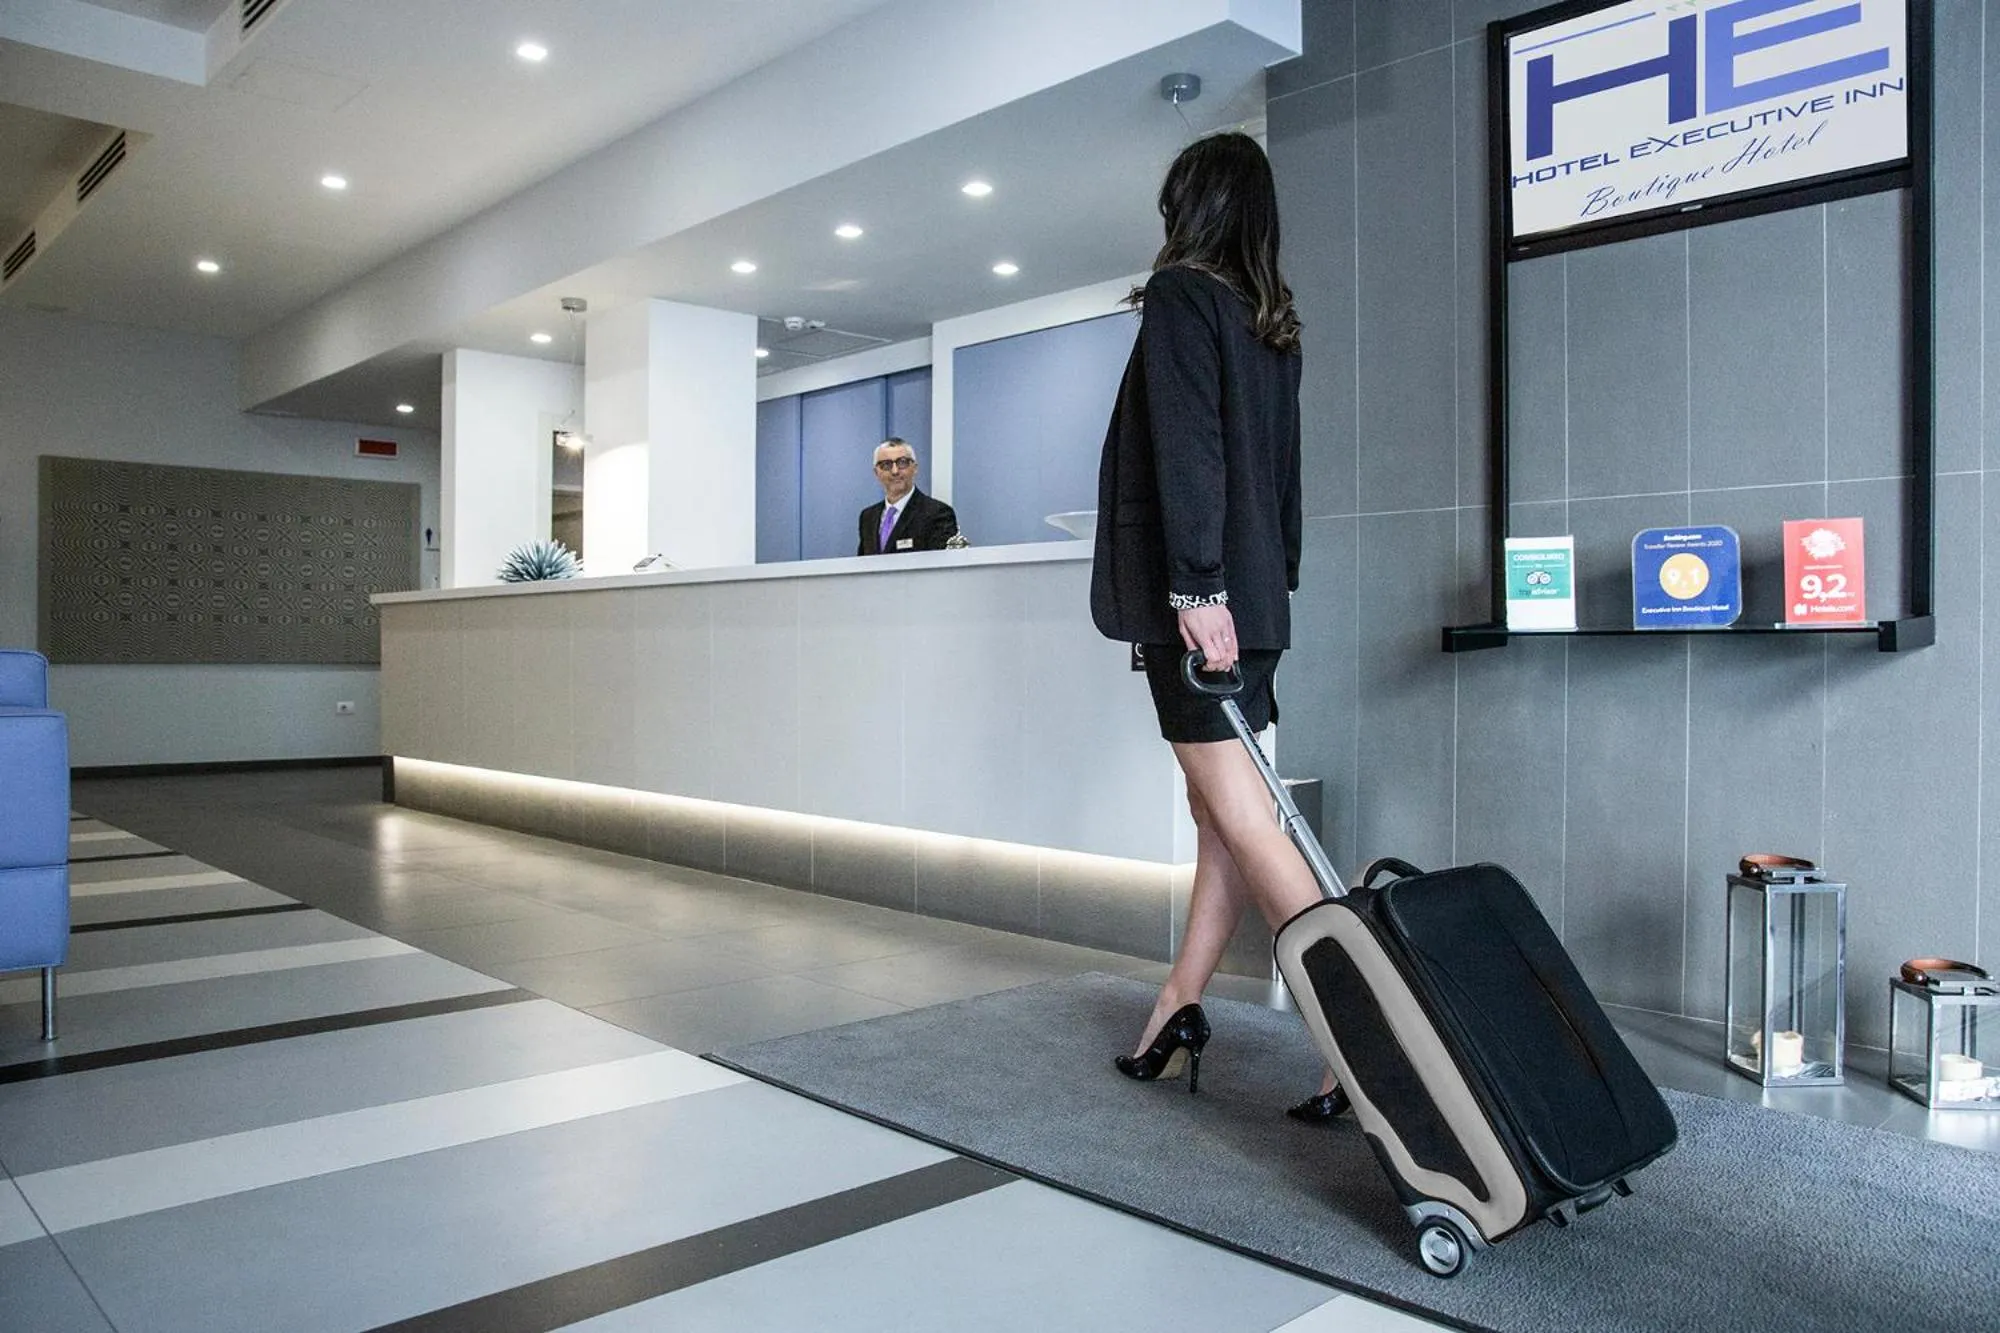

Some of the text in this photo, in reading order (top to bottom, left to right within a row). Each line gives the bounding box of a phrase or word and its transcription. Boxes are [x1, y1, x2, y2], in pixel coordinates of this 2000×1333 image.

[1512, 77, 1904, 189] HOTEL EXECUTIVE INN
[1580, 118, 1829, 217] Boutique Hotel
